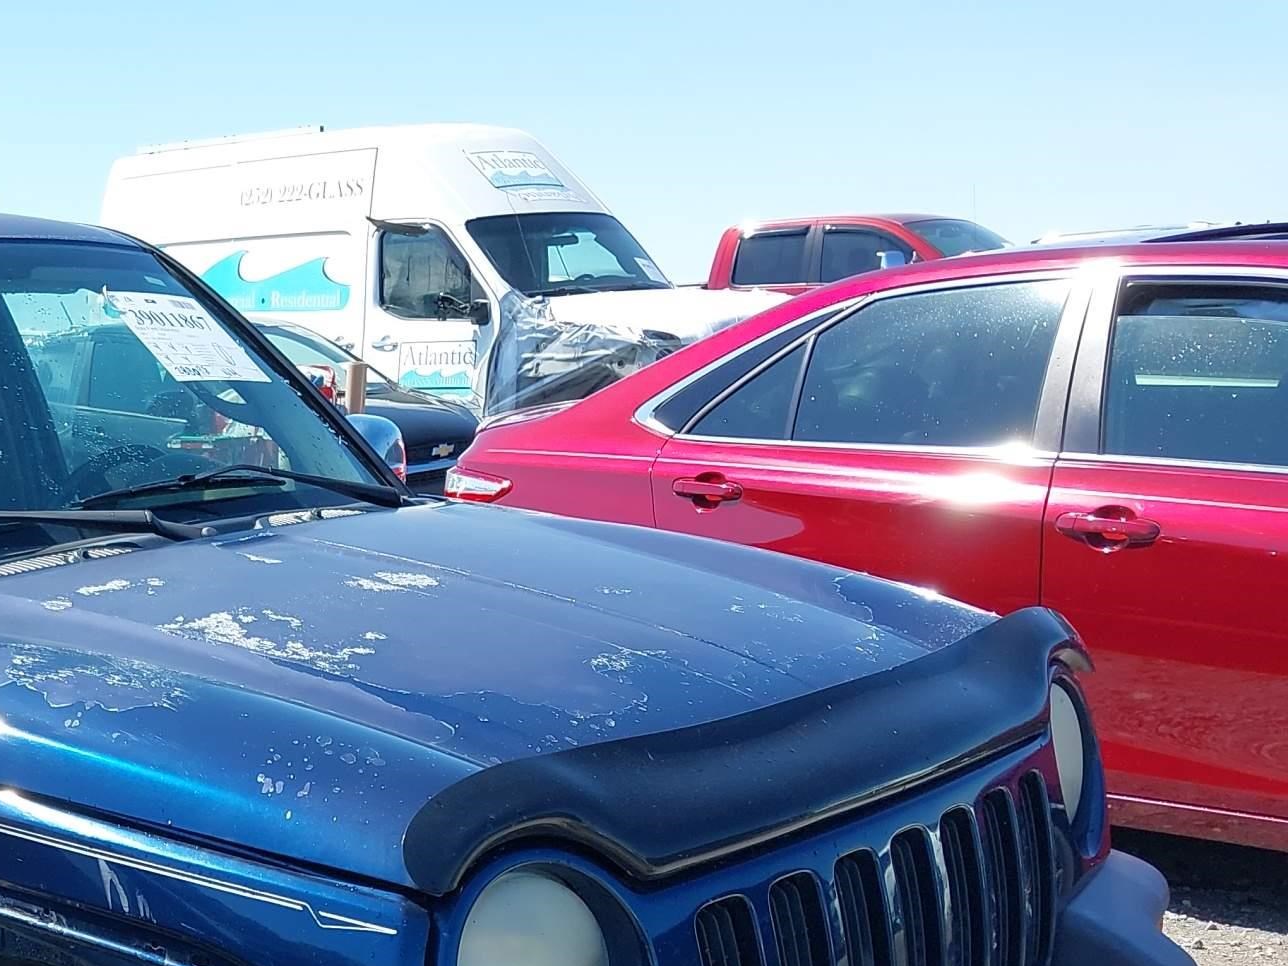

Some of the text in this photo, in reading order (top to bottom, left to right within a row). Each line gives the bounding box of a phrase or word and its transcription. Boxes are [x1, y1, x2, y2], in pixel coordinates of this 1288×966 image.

[475, 153, 547, 171] Atlantic
[128, 309, 212, 331] 39011867
[403, 344, 473, 366] Atlantic
